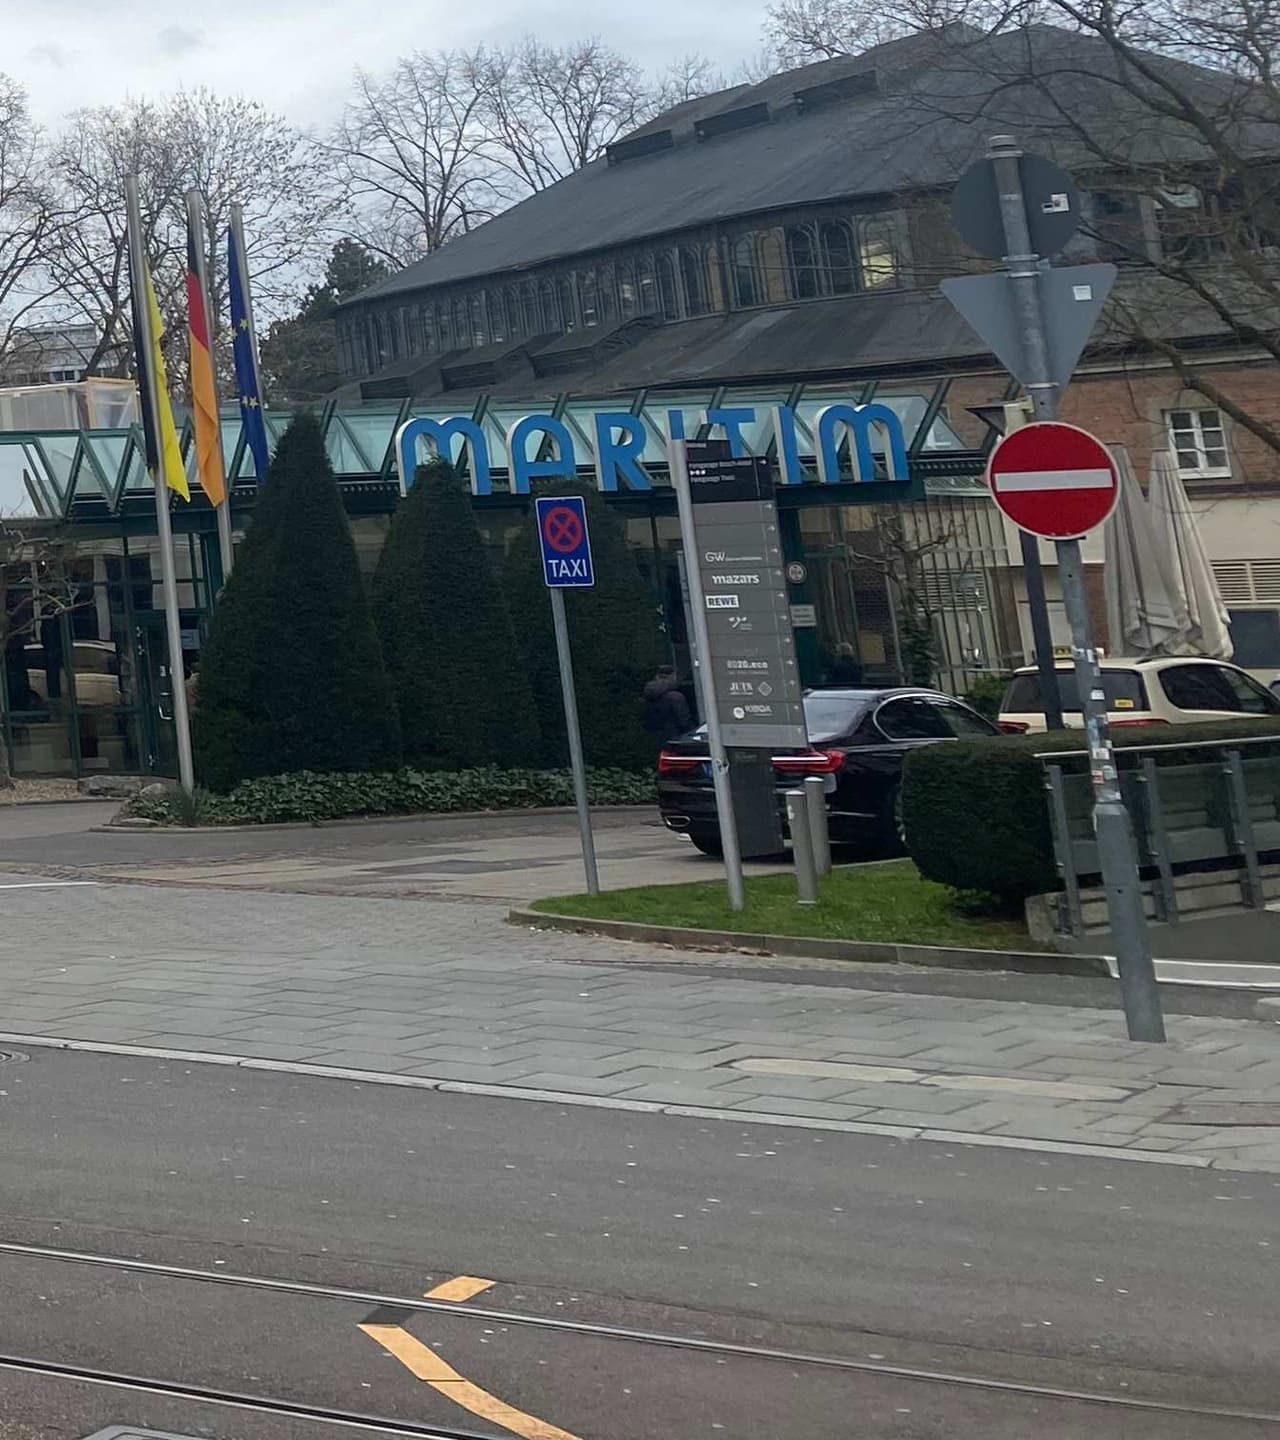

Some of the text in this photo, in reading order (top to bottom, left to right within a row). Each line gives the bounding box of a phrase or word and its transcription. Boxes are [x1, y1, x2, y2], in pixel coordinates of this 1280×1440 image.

[548, 558, 588, 578] TAXI
[712, 574, 760, 585] mazars
[708, 598, 736, 606] REWE
